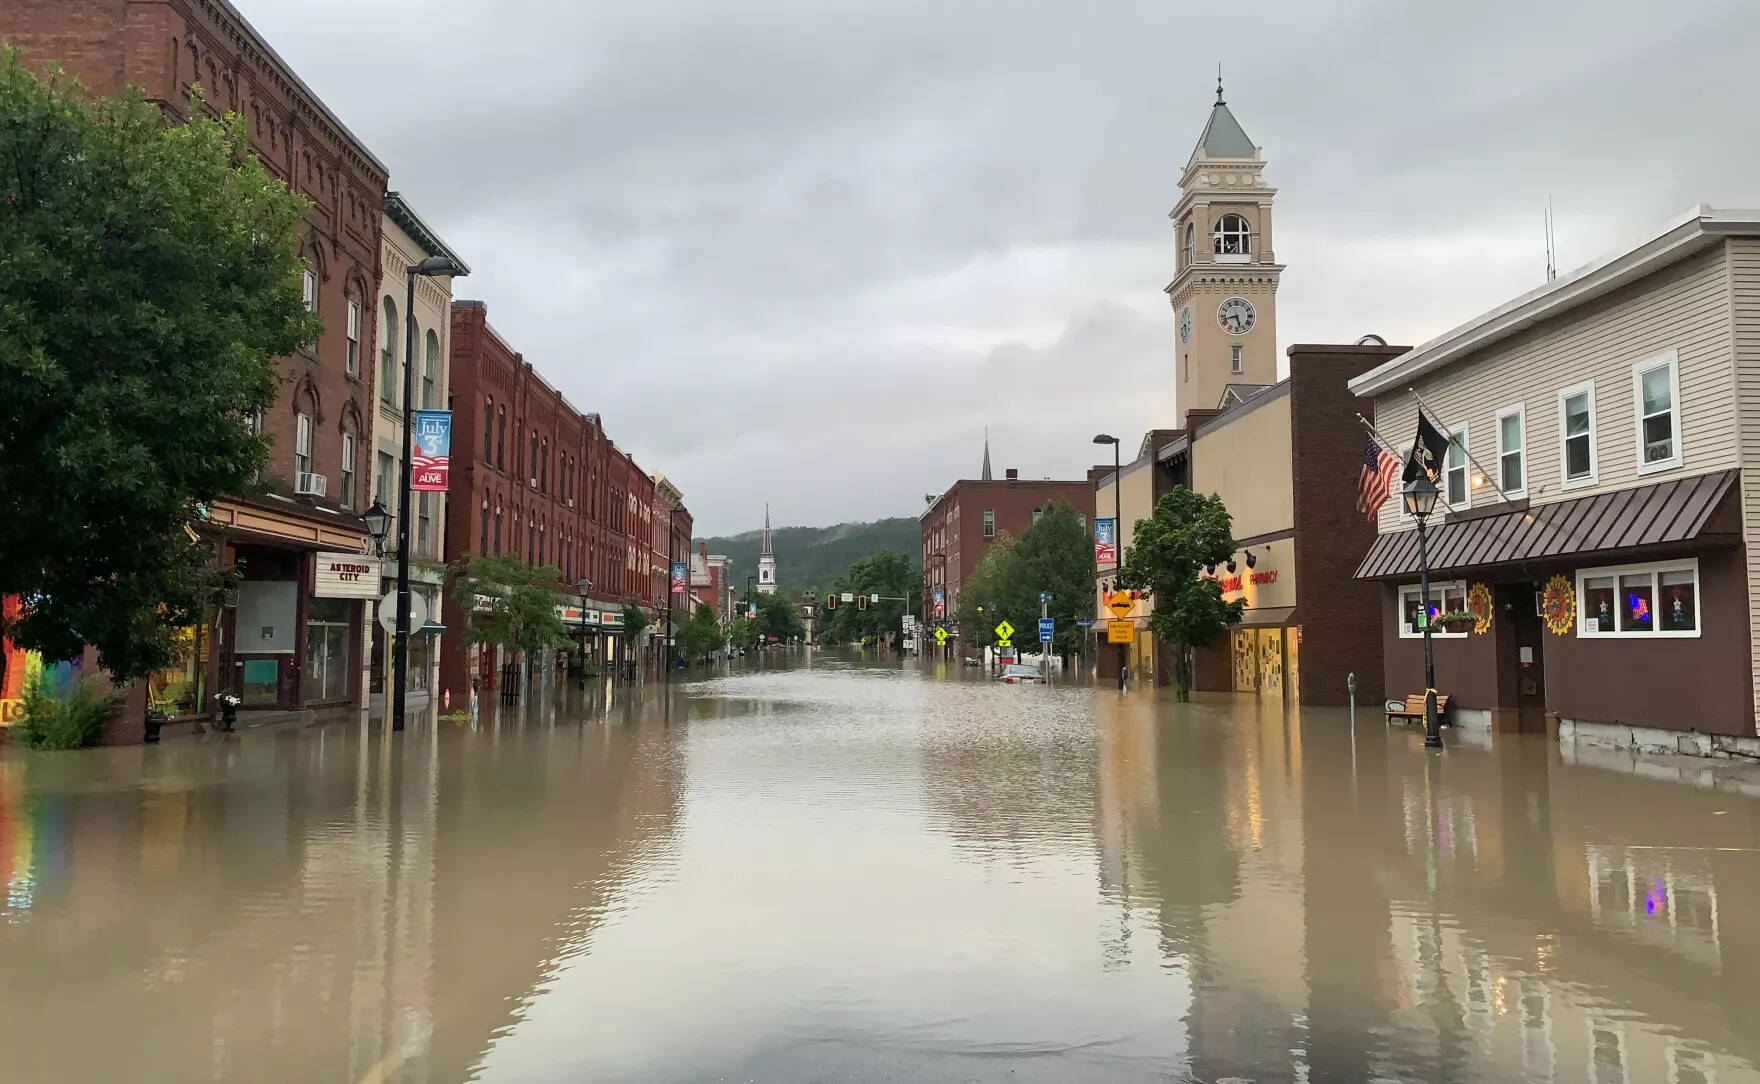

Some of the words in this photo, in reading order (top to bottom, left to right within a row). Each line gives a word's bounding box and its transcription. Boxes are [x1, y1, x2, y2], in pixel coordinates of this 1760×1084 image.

[418, 421, 448, 437] July
[418, 475, 442, 484] ALIVE
[1096, 524, 1112, 533] July
[330, 562, 370, 574] ASTEROID
[339, 572, 360, 582] CITY
